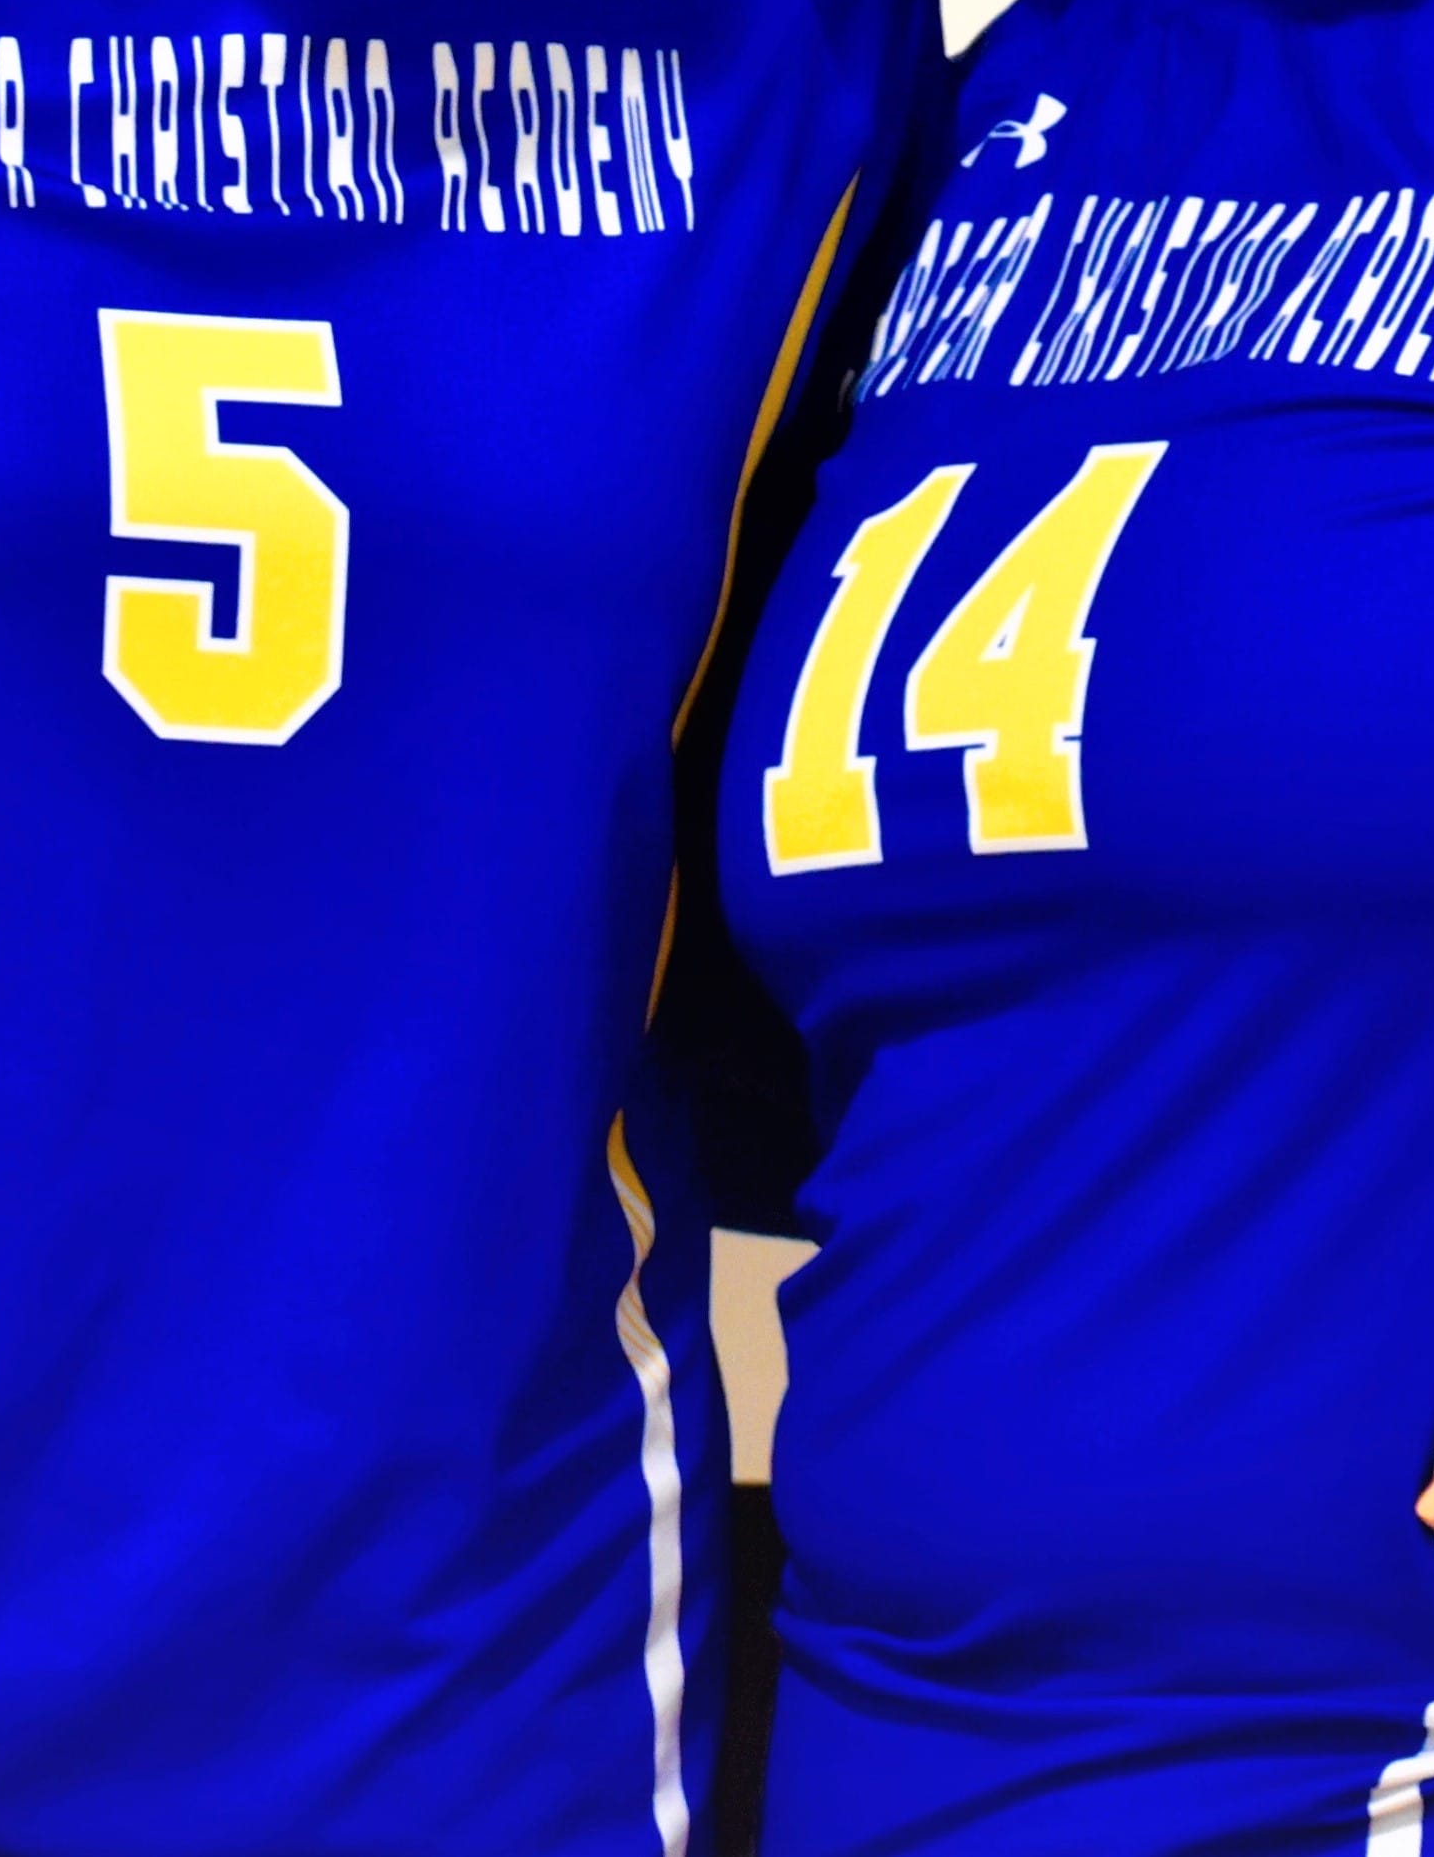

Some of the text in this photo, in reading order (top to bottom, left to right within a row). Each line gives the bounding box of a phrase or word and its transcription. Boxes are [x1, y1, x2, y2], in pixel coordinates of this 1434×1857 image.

[68, 31, 406, 226] CHRISTIAN
[431, 40, 695, 238] ACADEMY
[97, 307, 350, 747] 5
[762, 439, 1170, 877] 14
